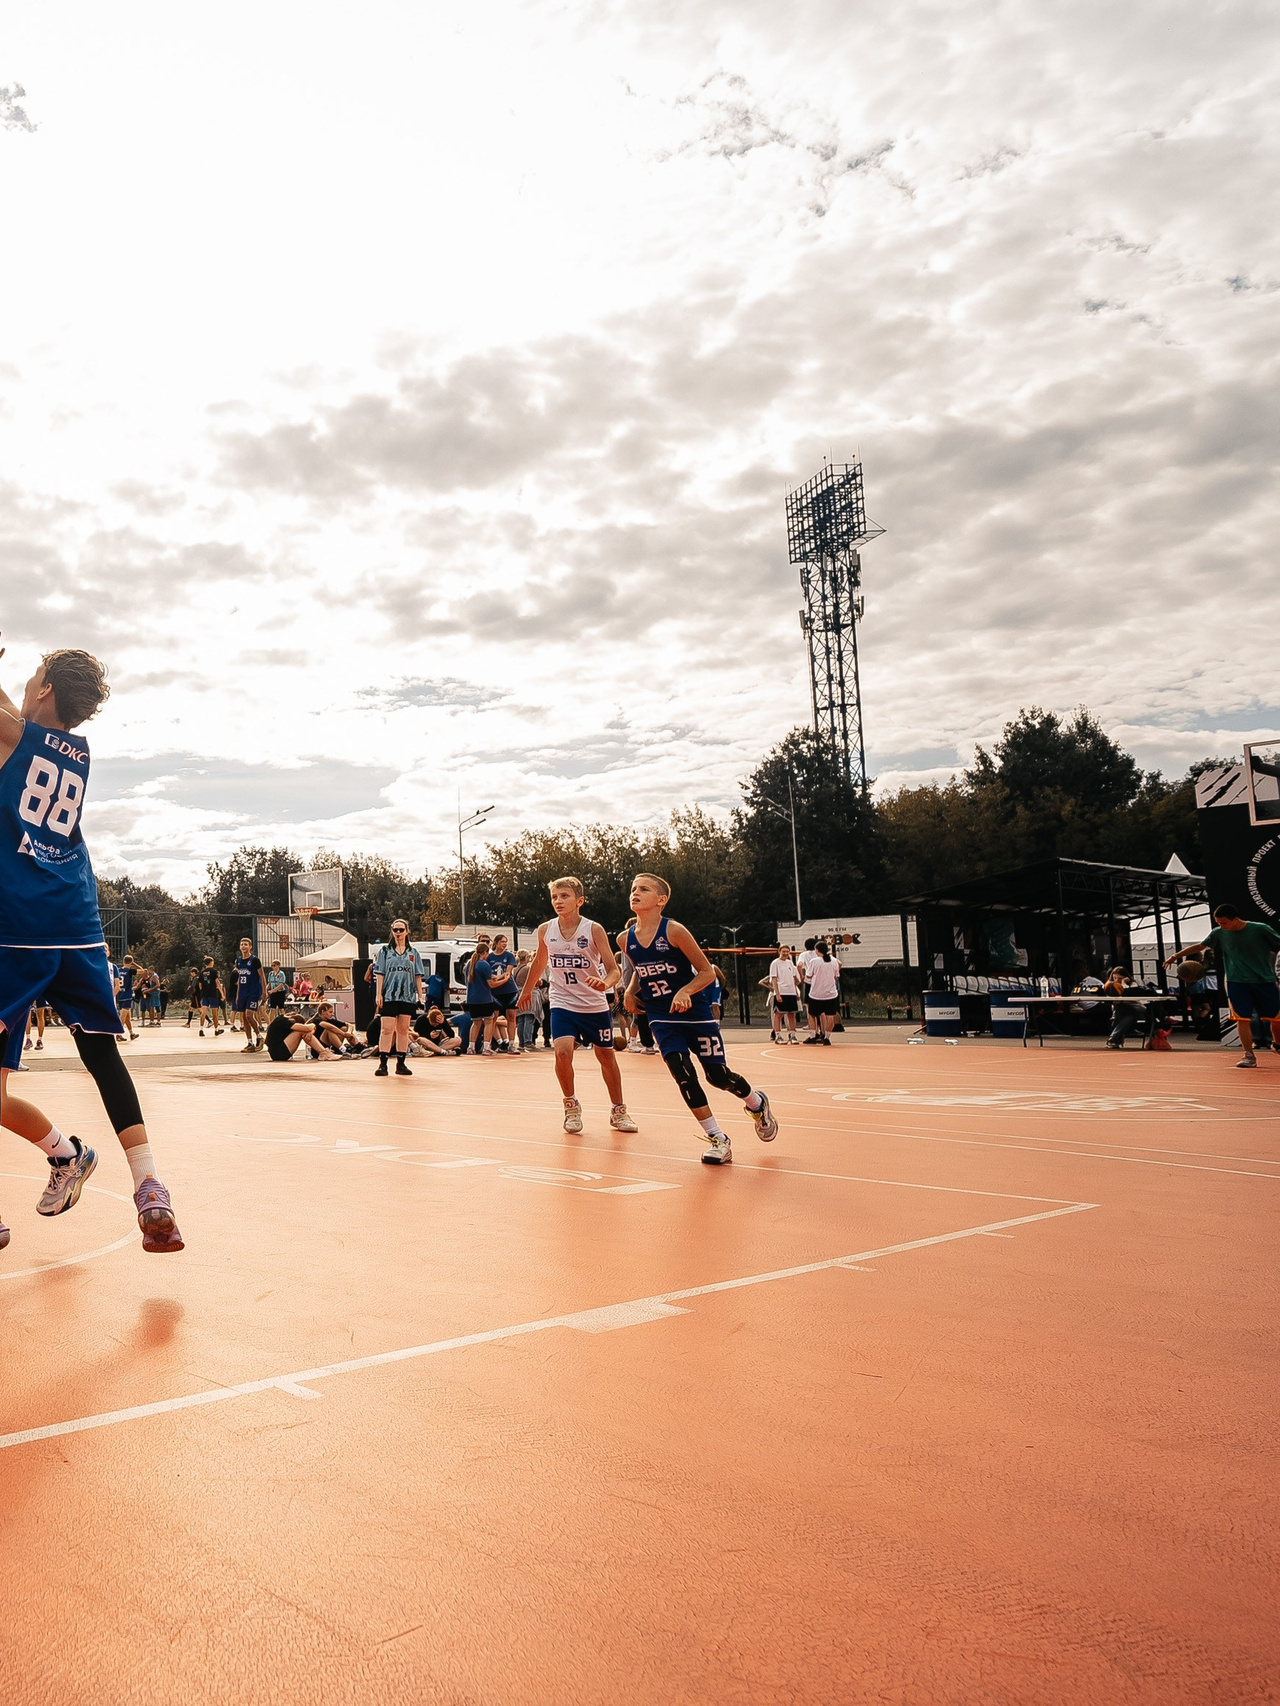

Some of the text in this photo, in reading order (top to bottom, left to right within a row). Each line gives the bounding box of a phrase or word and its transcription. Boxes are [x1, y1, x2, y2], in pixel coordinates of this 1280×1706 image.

[58, 741, 88, 765] DKC
[18, 754, 85, 838] 88
[33, 839, 61, 855] Альфа
[1252, 839, 1276, 863] ПРОЕКТ
[240, 976, 247, 984] 23
[563, 971, 578, 985] 19
[648, 980, 673, 998] 32
[598, 1028, 612, 1042] 19
[697, 1036, 724, 1057] 32
